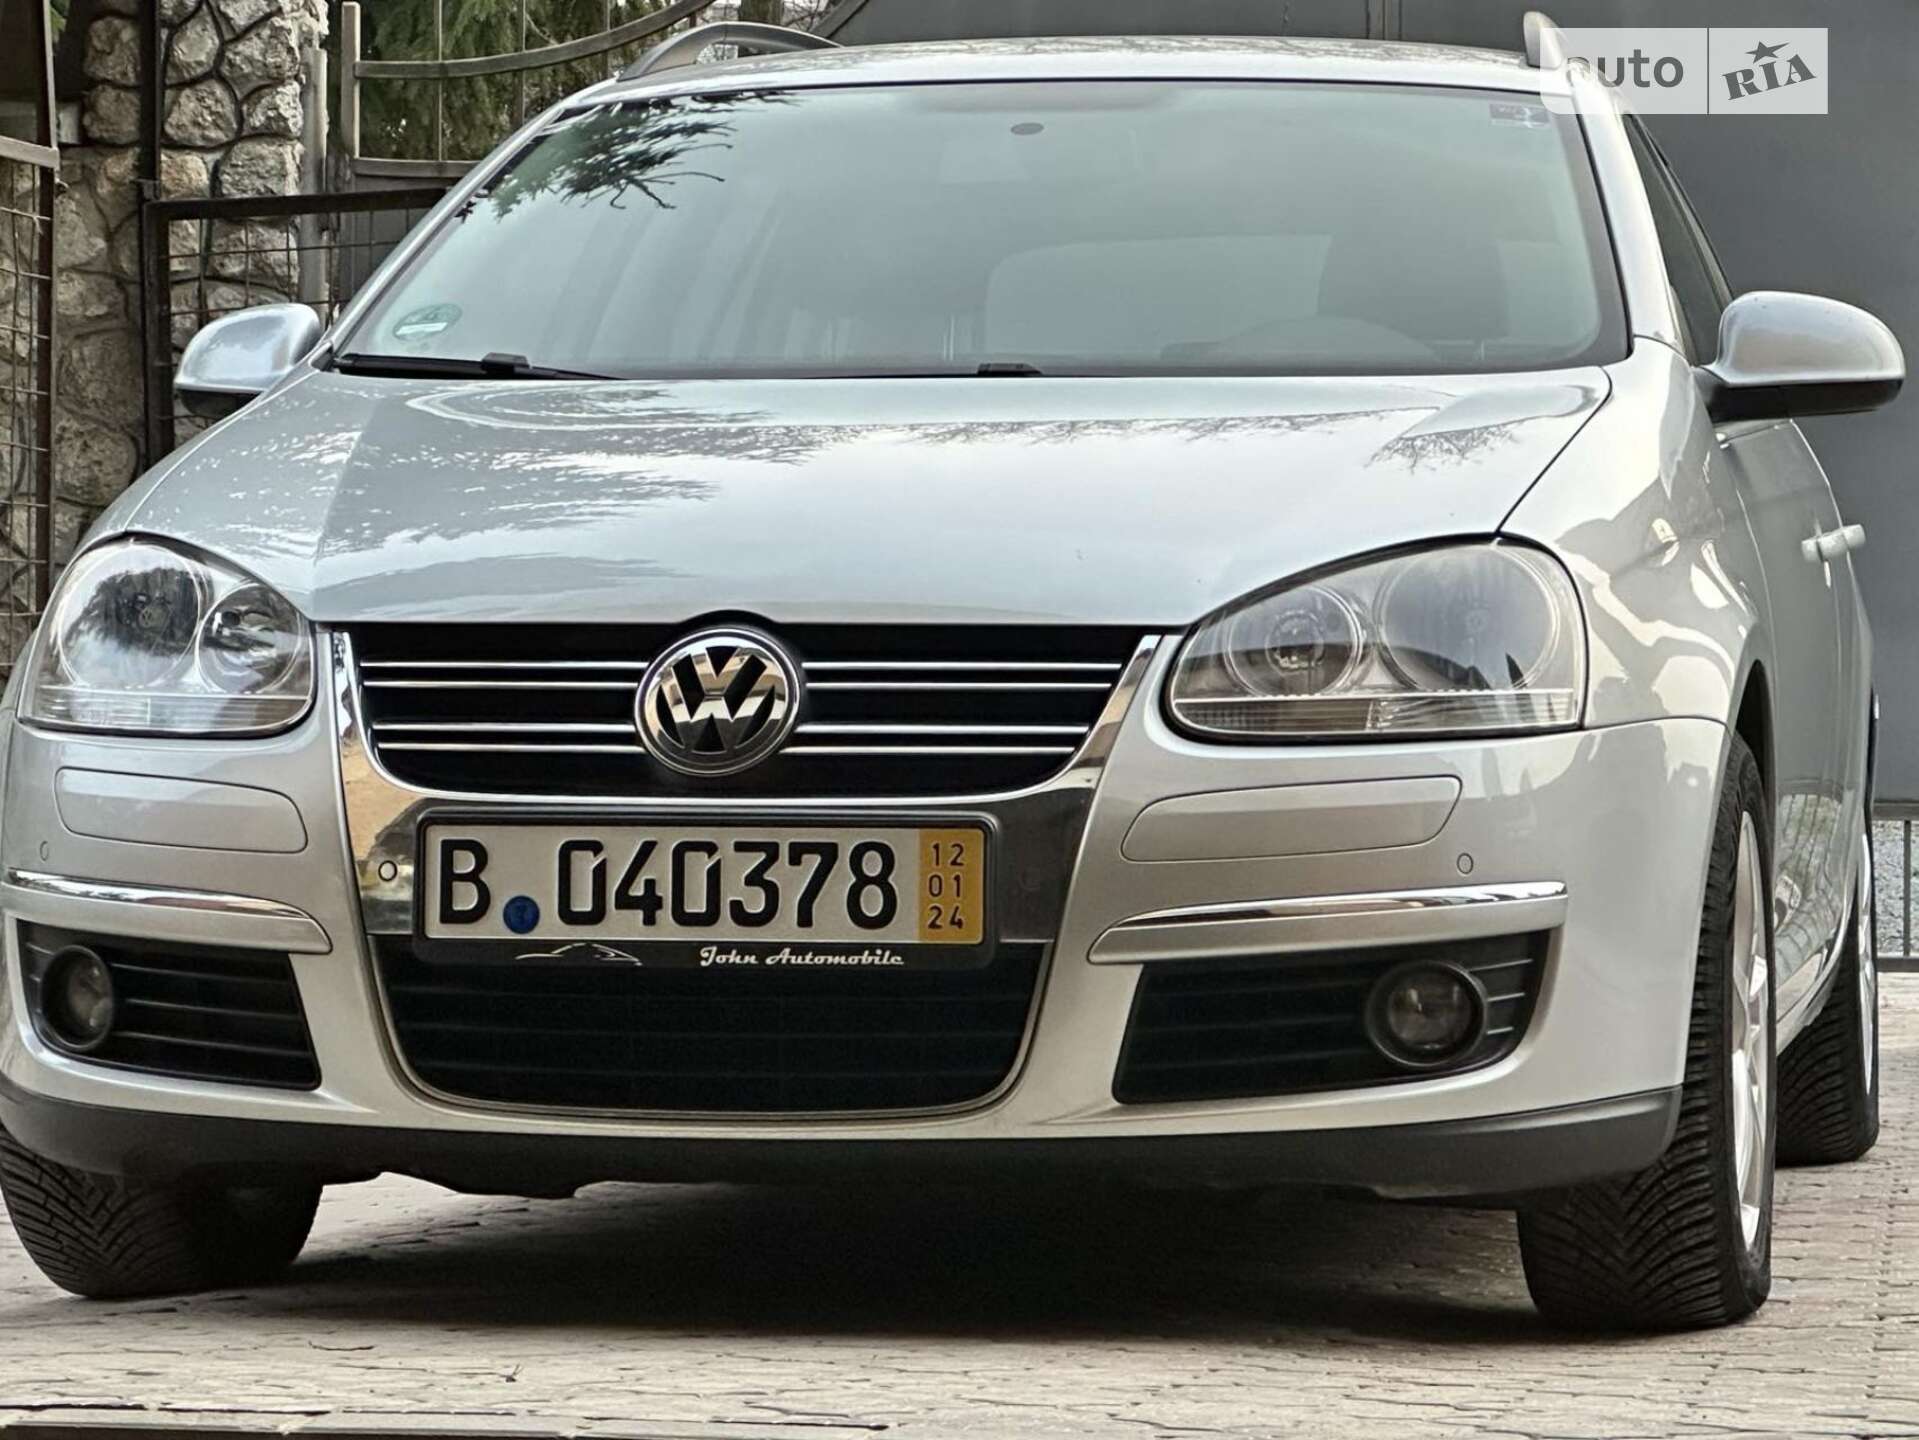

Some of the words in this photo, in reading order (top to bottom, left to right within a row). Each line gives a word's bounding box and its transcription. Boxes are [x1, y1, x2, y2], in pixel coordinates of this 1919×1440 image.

[932, 843, 965, 866] 12
[439, 839, 490, 925] B
[557, 840, 898, 929] 040378
[928, 874, 961, 898] 01
[927, 905, 963, 929] 24
[700, 945, 759, 967] John
[765, 947, 904, 966] Automobile
